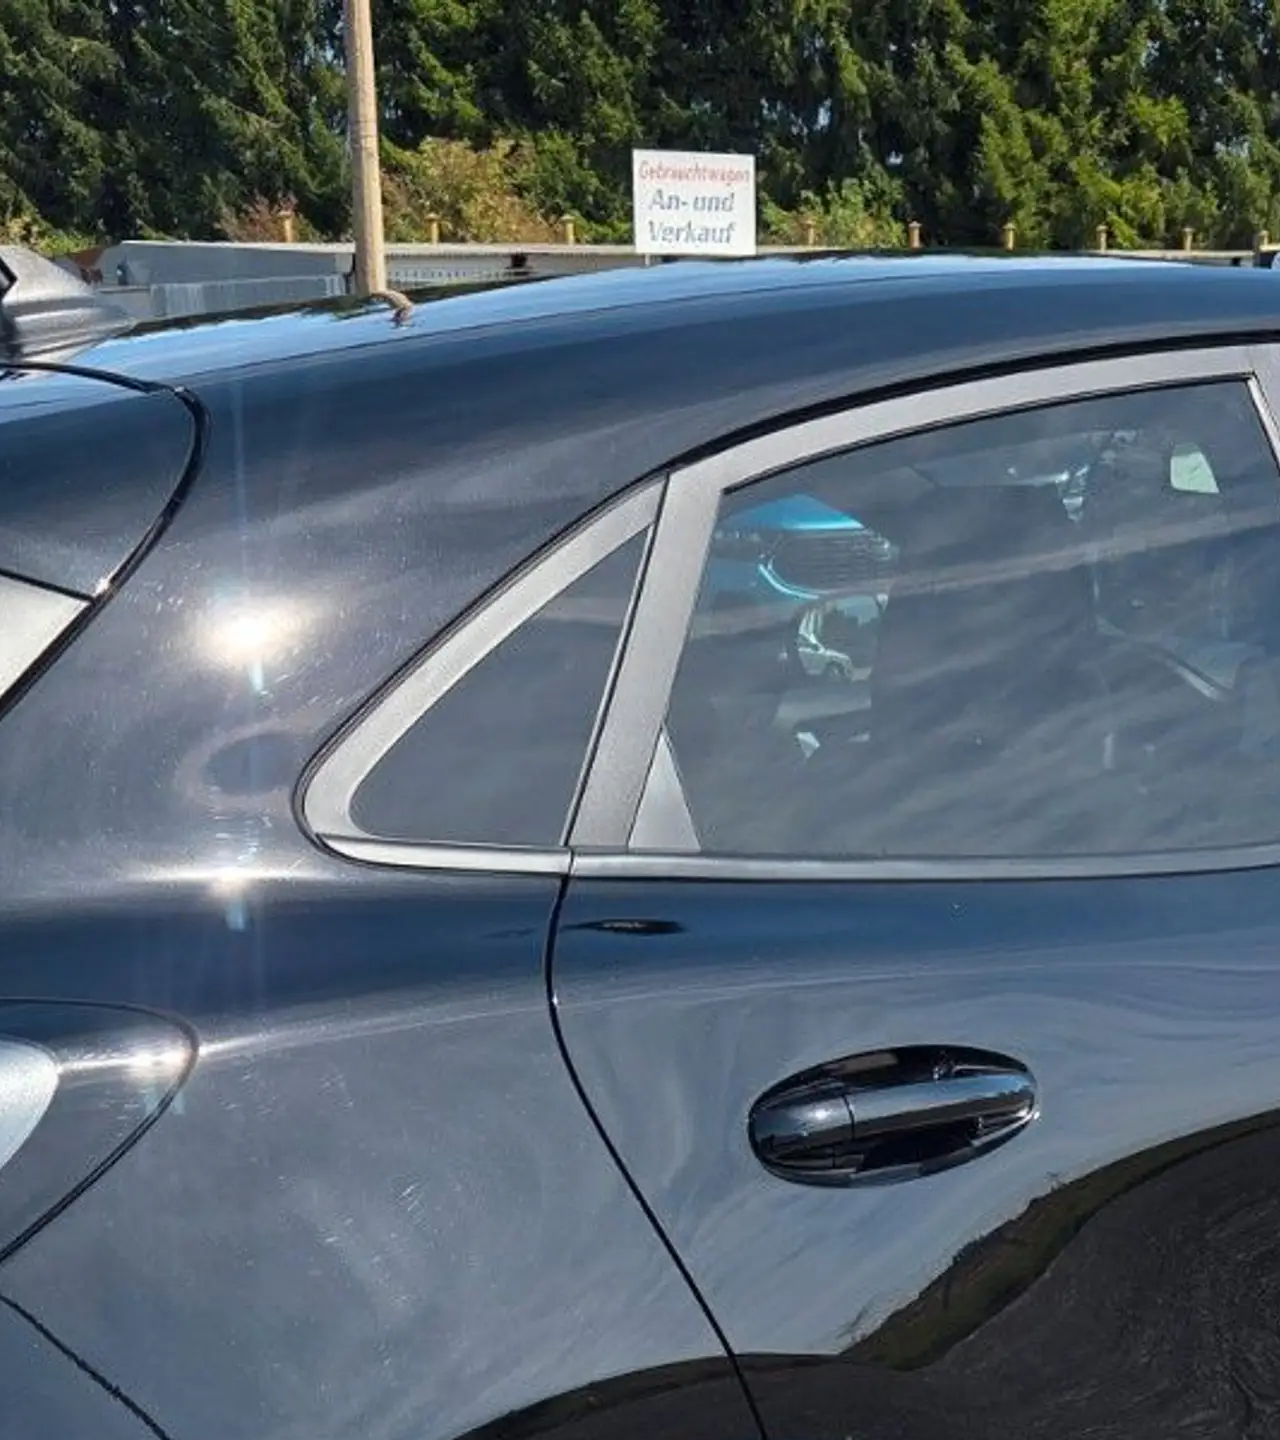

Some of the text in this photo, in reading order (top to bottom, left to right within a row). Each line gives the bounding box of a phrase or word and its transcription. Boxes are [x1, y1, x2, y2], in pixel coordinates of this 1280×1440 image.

[639, 160, 750, 185] Gebrauchtwagen
[648, 188, 735, 212] An- und
[648, 220, 736, 244] Verkauf
